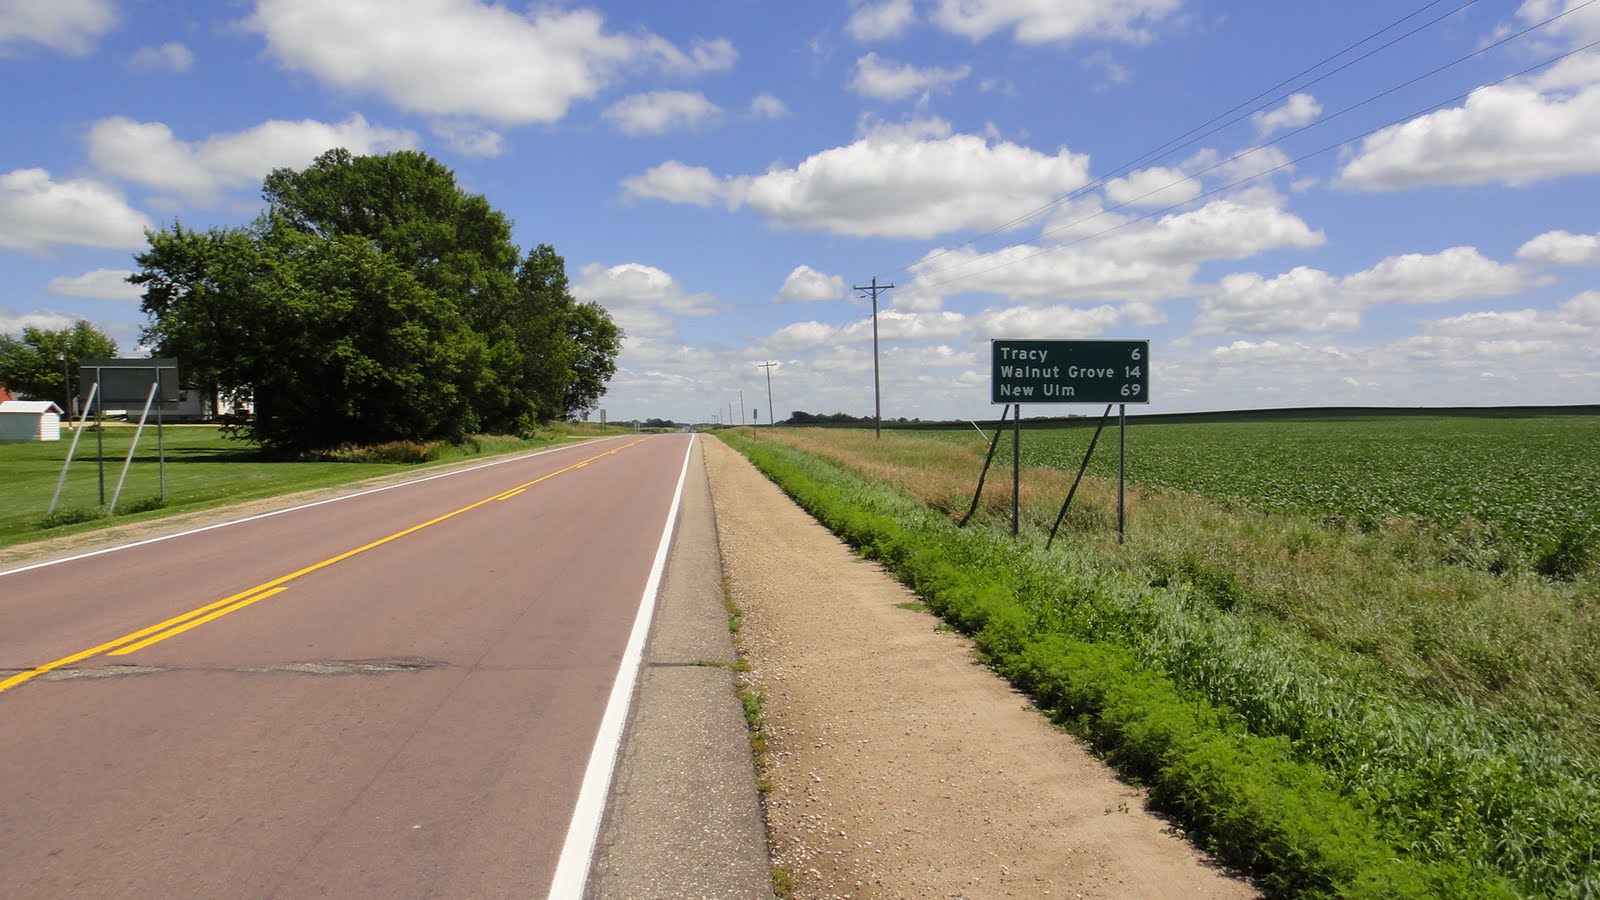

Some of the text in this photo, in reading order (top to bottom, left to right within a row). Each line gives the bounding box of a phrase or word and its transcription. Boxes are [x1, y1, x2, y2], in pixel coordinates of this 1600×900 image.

[1000, 347, 1141, 363] Tracy 6
[1000, 365, 1141, 378] Walnut Grove 14
[1000, 383, 1141, 396] New Ulm 69
